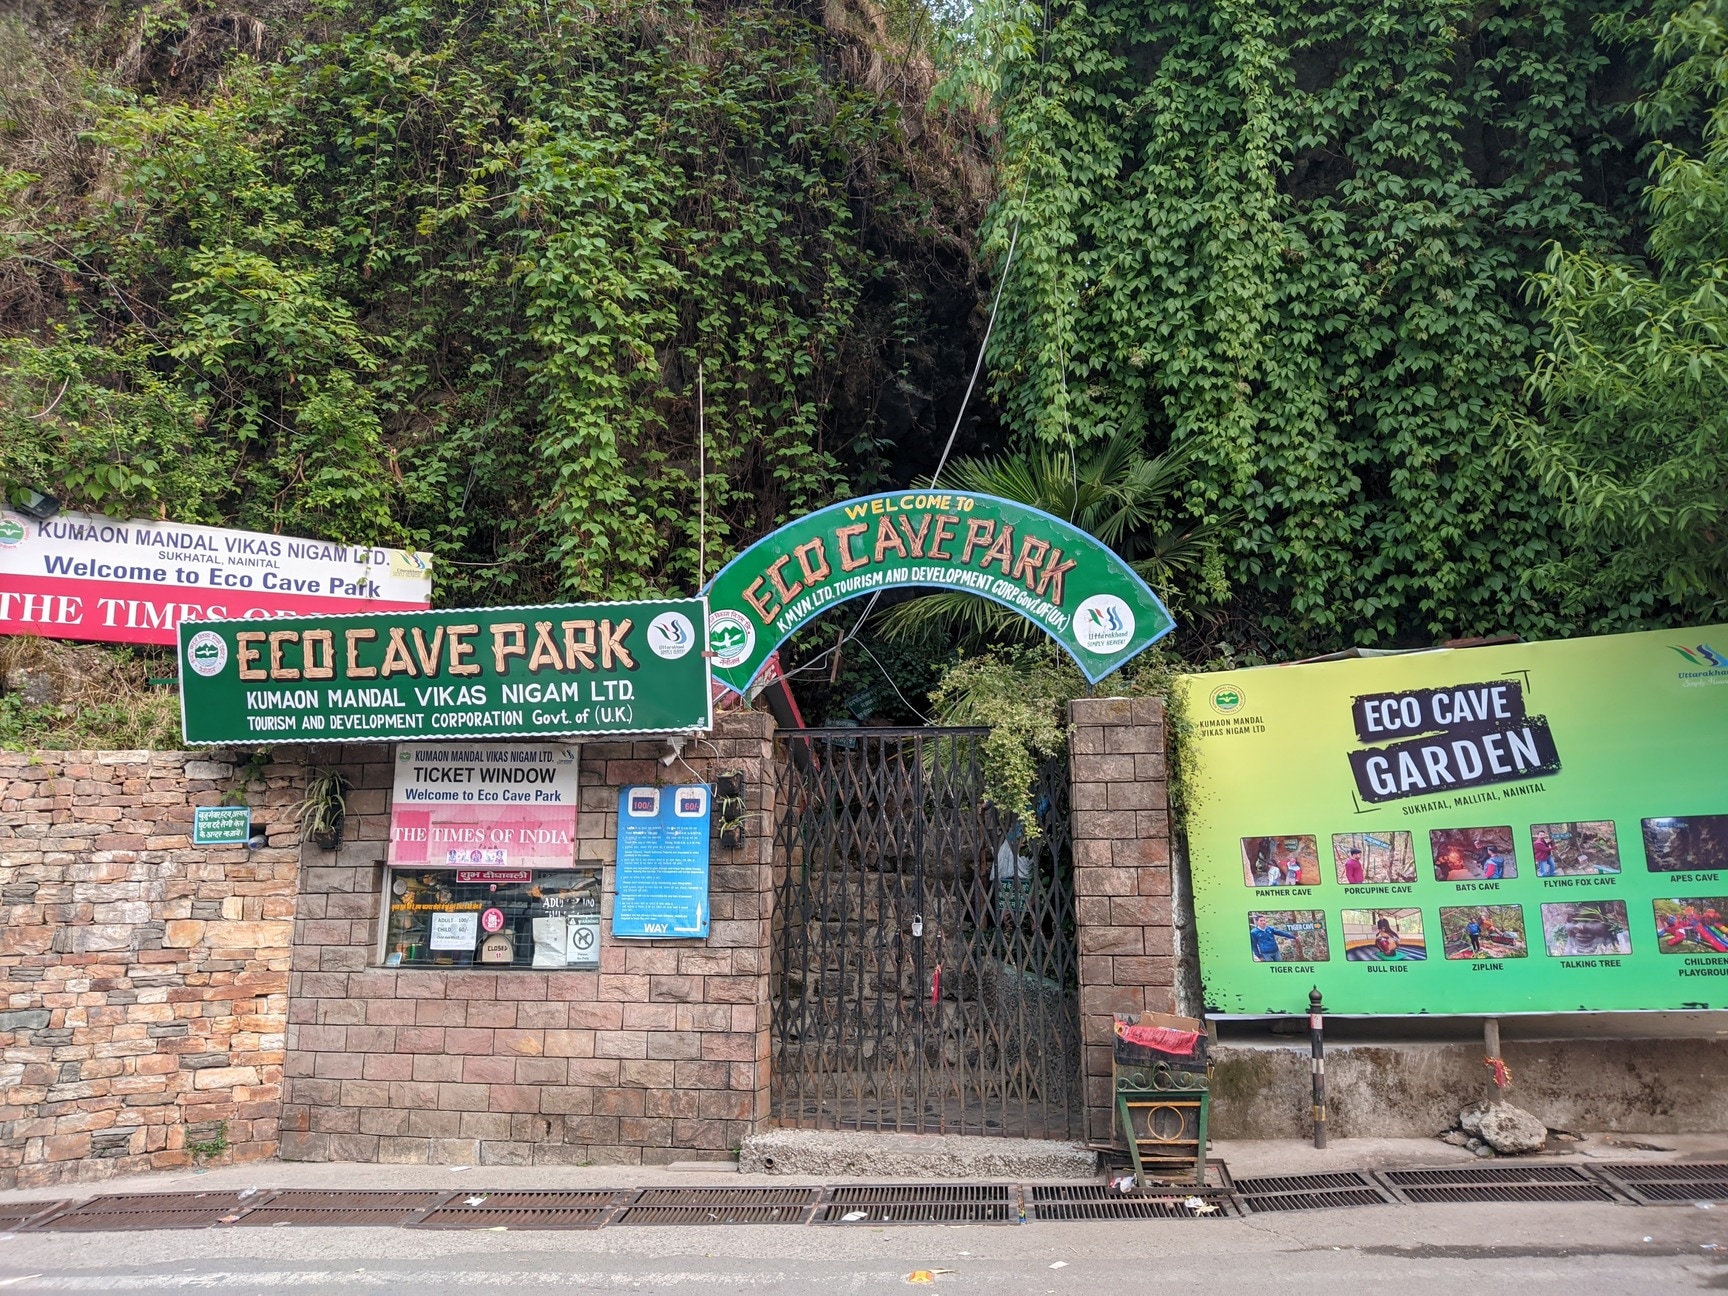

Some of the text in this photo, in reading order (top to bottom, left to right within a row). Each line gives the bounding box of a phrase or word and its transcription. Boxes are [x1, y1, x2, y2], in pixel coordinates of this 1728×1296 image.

[845, 496, 974, 520] WELCOME TO
[38, 521, 129, 545] KUMAON
[136, 529, 219, 552] MANDAL
[225, 537, 281, 557] VIKAS
[288, 542, 347, 563] NIGAM
[354, 548, 390, 567] LTD.
[158, 550, 280, 570] SUKHATAL, NAINITAL
[742, 513, 1076, 625] ECO CAVE PARK
[44, 555, 381, 598] Welcome to Eco Cave Park
[833, 571, 882, 597] TOURISM
[885, 568, 907, 583] AND
[912, 566, 994, 591] DEVELOPMENT
[0, 592, 84, 625] THE
[236, 629, 335, 678] ECO
[345, 625, 481, 678] CAVE
[490, 618, 634, 673] PARK
[1678, 670, 1728, 679] Uttarakha
[247, 680, 635, 709] KUMAON MANDAL VIKAS NIGAM LTD.
[1363, 687, 1511, 732] ECO CAVE
[247, 703, 633, 731] TOURISM AND DEVELOPMENT CORPORATION Govt. of (U.K.)
[1199, 716, 1264, 729] KUMAON MANDAL
[1201, 725, 1266, 738] VIKAS NIGAM LTD
[415, 750, 449, 763] KUMAON
[451, 750, 484, 763] MANDAL
[486, 750, 509, 763] VIKAS
[511, 750, 537, 763] NIGAM
[539, 751, 554, 764] LTD.
[1365, 727, 1542, 796] GARDEN
[414, 767, 556, 784] TICKET WINDOW
[405, 788, 561, 803] Welcome to Eco Cave Park
[1402, 783, 1546, 816] SUKHATAL, MALLITAL, NAINITAL
[393, 827, 569, 845] THE TIMES OF INDIA
[460, 870, 528, 881] शुभ दीपावली
[1543, 877, 1616, 888] FLYING FOX CAVE
[1670, 873, 1719, 883] APES CAVE
[1256, 888, 1312, 898] PANTHER CAVE
[1344, 886, 1413, 896] PORCUPINE CAVE
[1456, 882, 1500, 891] BATS CAVE
[644, 923, 669, 934] WAY
[1270, 965, 1315, 974] TIGER CAVE
[1367, 965, 1408, 973] BULL RIDE
[1472, 963, 1504, 971] ZIPLINE
[1560, 959, 1621, 969] TALKING TREE
[1678, 968, 1728, 977] PLAYGROU
